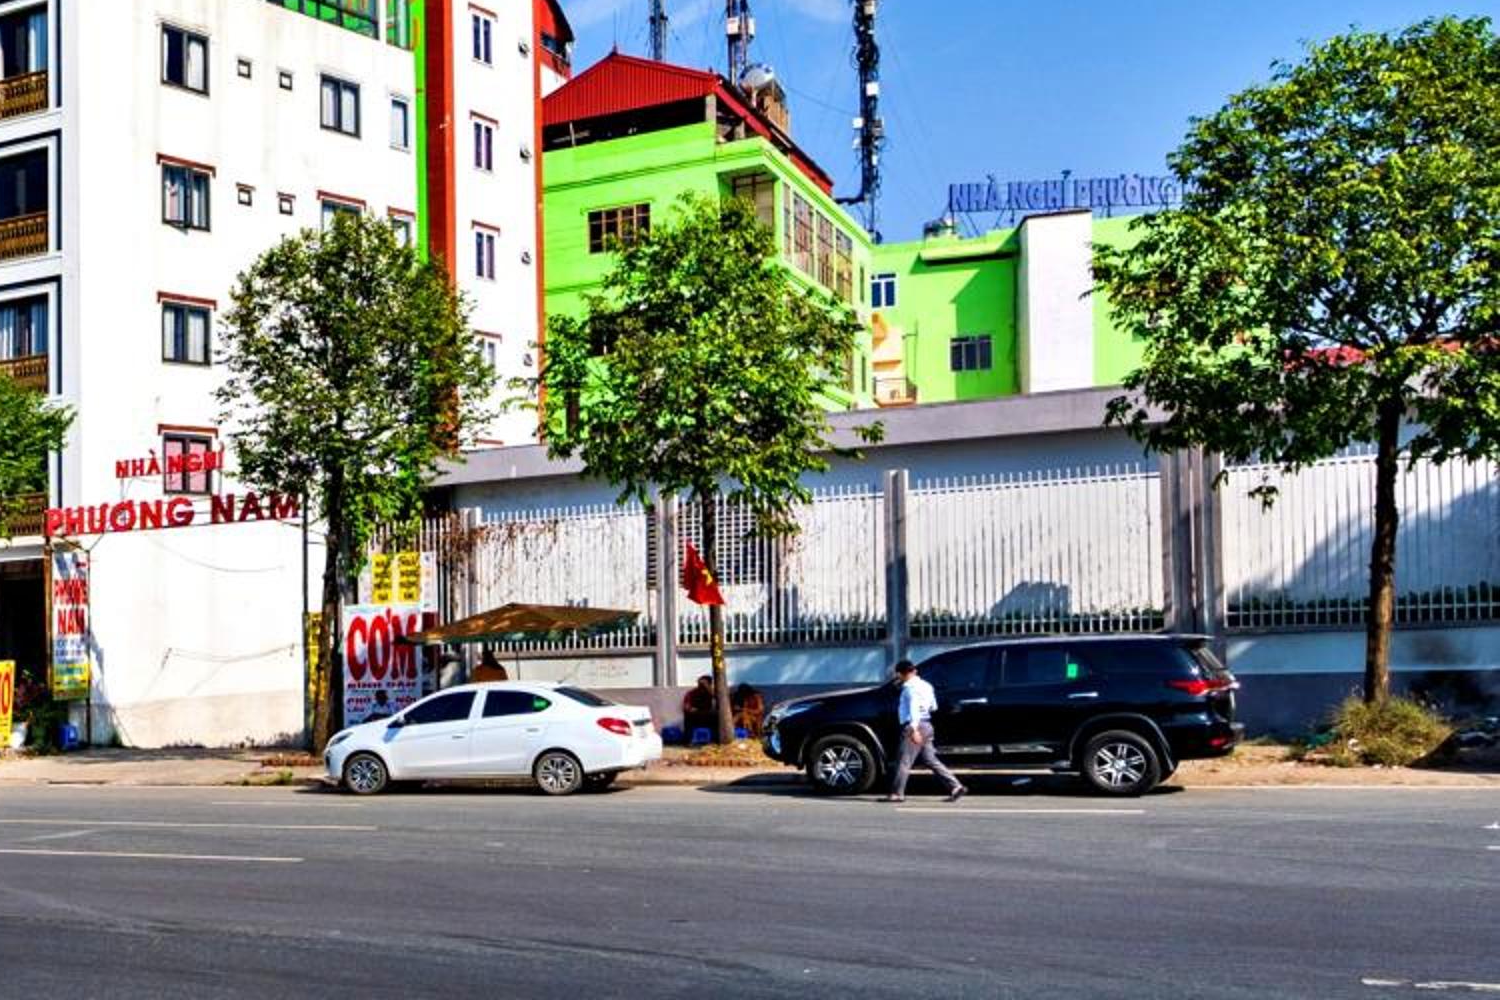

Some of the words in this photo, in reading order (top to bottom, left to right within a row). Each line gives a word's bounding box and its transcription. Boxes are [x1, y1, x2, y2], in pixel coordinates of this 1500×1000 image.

[115, 449, 161, 479] NHÀ
[211, 490, 303, 525] NAM
[57, 608, 86, 636] NAM
